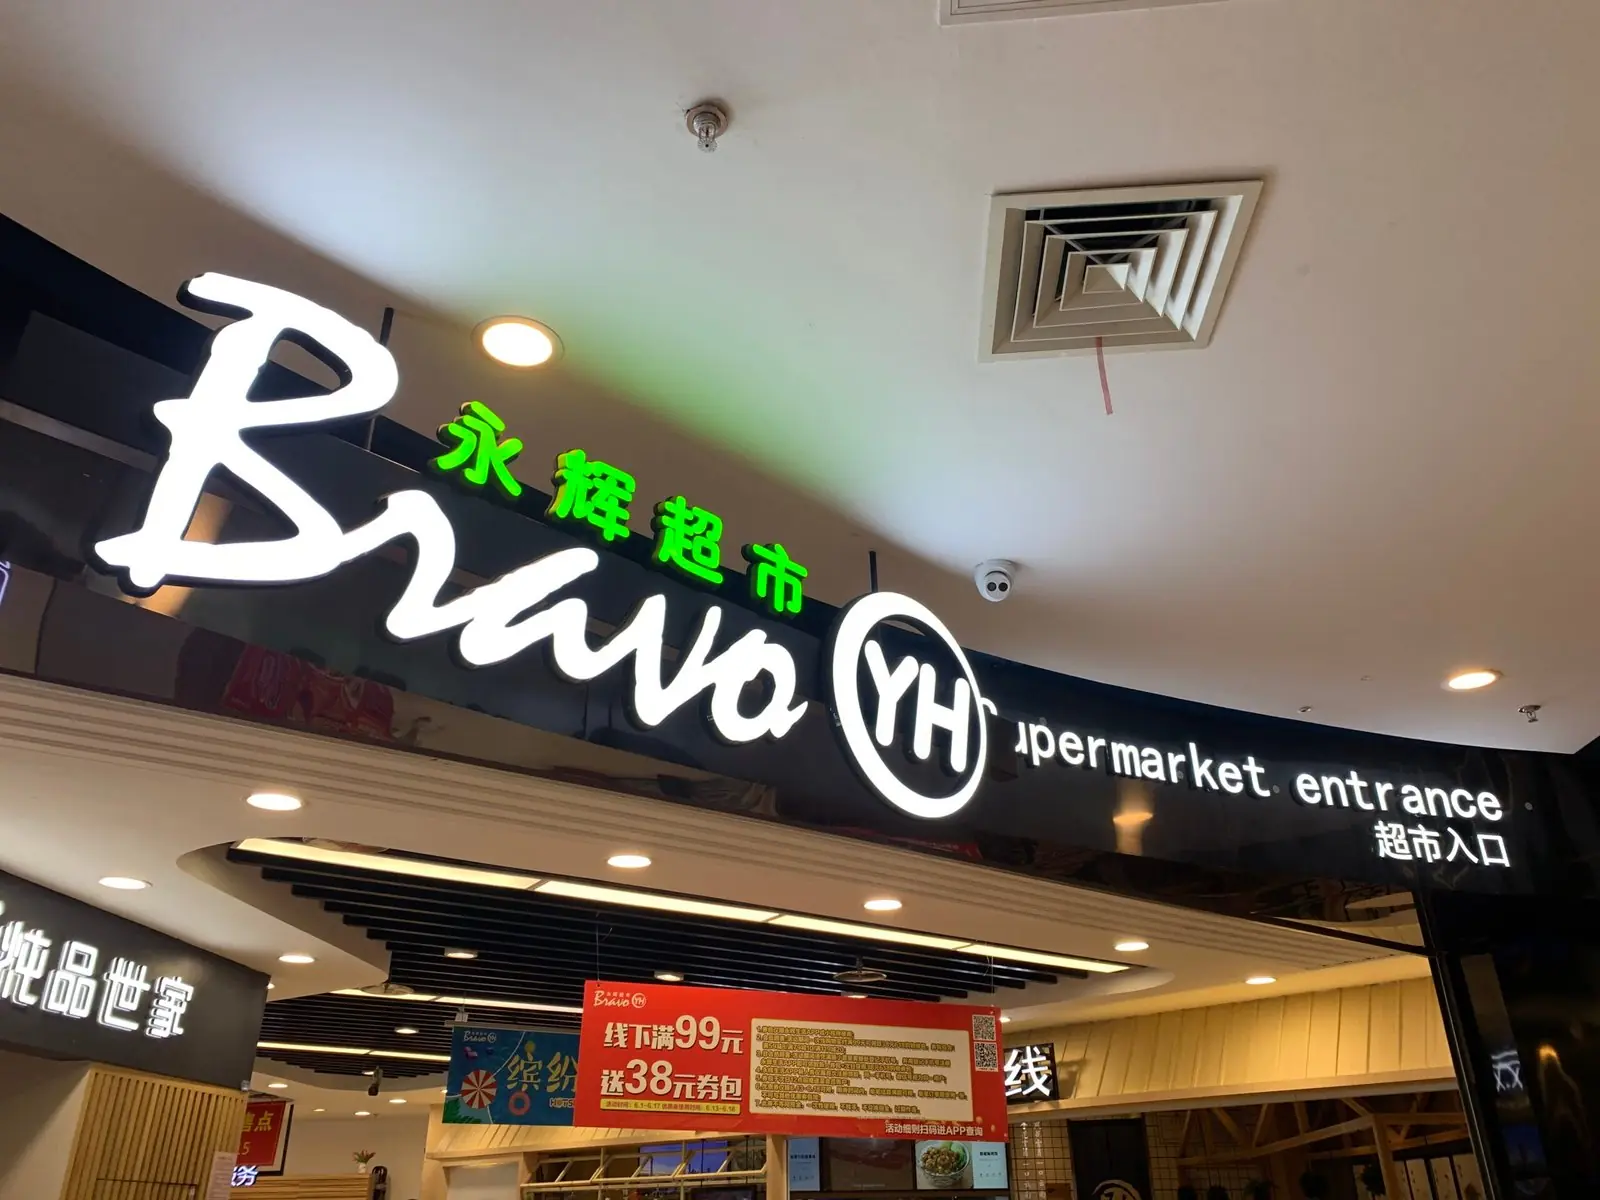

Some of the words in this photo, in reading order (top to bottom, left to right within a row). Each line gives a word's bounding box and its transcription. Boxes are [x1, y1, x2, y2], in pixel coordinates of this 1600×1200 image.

[94, 271, 809, 743] Bravo
[436, 401, 809, 614] 永辉超市
[1296, 770, 1503, 821] entrance
[1374, 820, 1511, 868] 超市入口
[593, 990, 630, 1007] Bravo
[603, 1014, 744, 1054] 线下满99元
[506, 1051, 579, 1093] 缤纷
[600, 1058, 742, 1100] 送38元券包
[1003, 1045, 1049, 1097] 线
